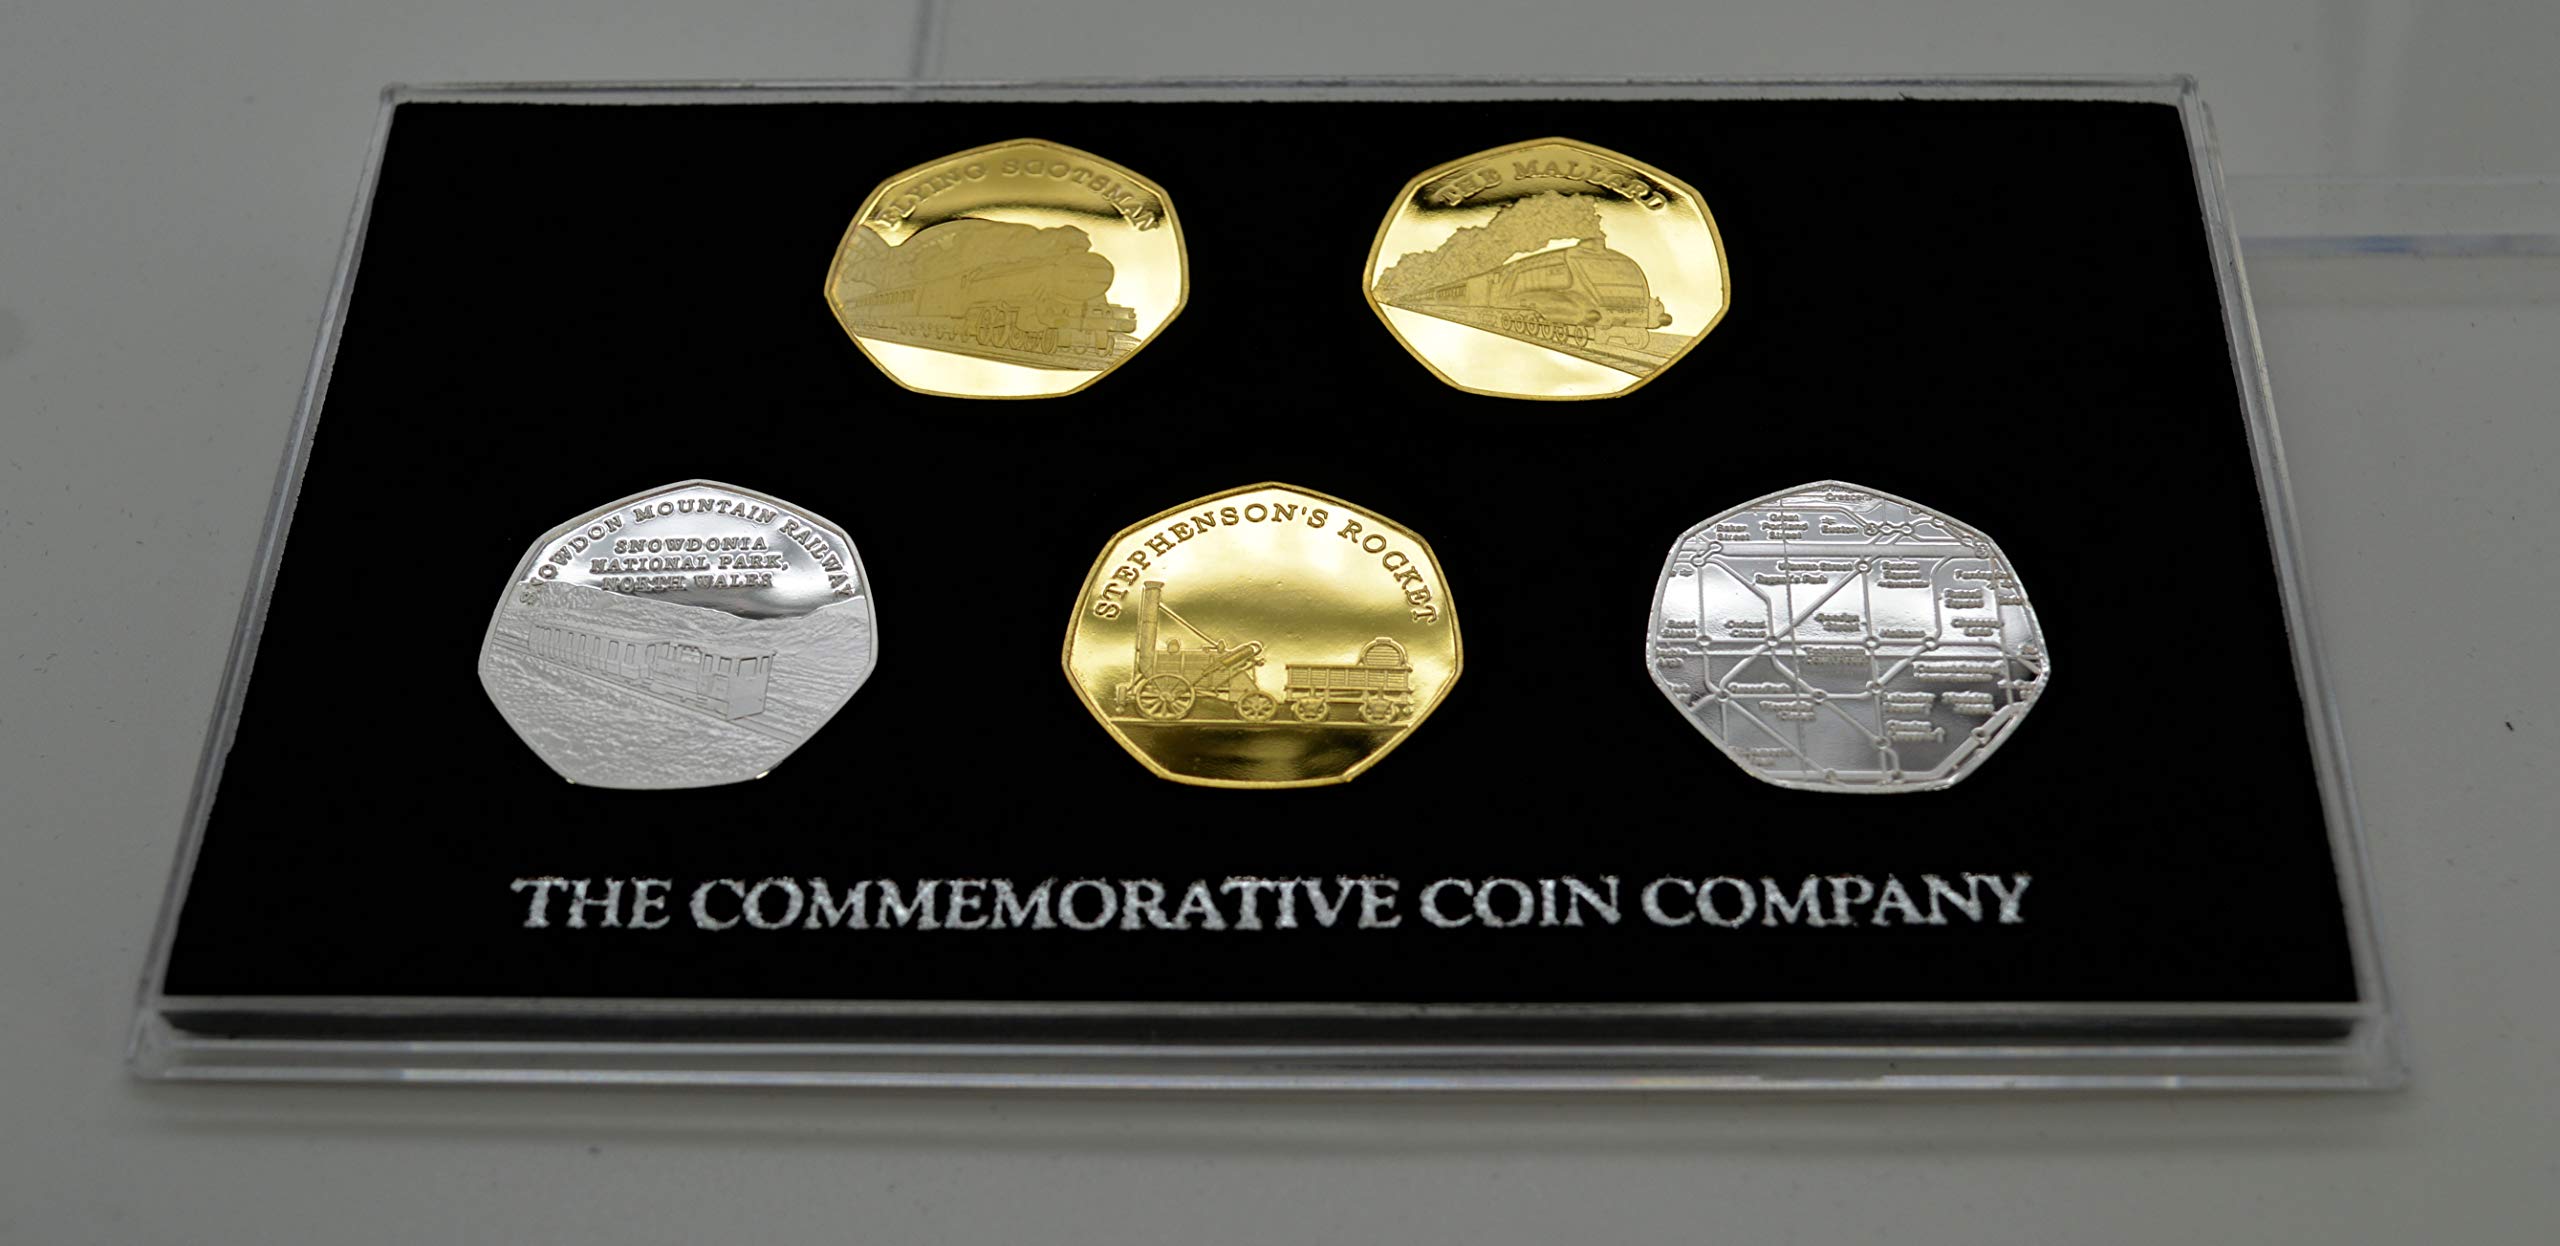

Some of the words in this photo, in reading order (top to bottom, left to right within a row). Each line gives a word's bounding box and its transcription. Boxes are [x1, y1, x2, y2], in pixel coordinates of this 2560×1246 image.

[876, 161, 989, 230] FLYING
[1001, 158, 1160, 231] SCOTSMAN
[1434, 167, 1503, 207] THE
[1513, 159, 1668, 211] MALLARD
[588, 556, 712, 575] NATIONAL
[717, 553, 790, 573] PARK,
[614, 536, 769, 555] SNOWDONIA
[633, 498, 778, 523] MOUNTAIN
[780, 518, 856, 599] RAILWAY
[1094, 503, 1329, 621] STEPHENSON'S
[1337, 518, 1438, 626] ROCKET
[601, 574, 688, 594] NORTH
[694, 572, 774, 591] WALES
[510, 875, 673, 930] THE
[689, 875, 1402, 932] COMMEMORATIVE
[1419, 875, 1622, 930] COIN
[1641, 872, 2033, 929] COMPANY
